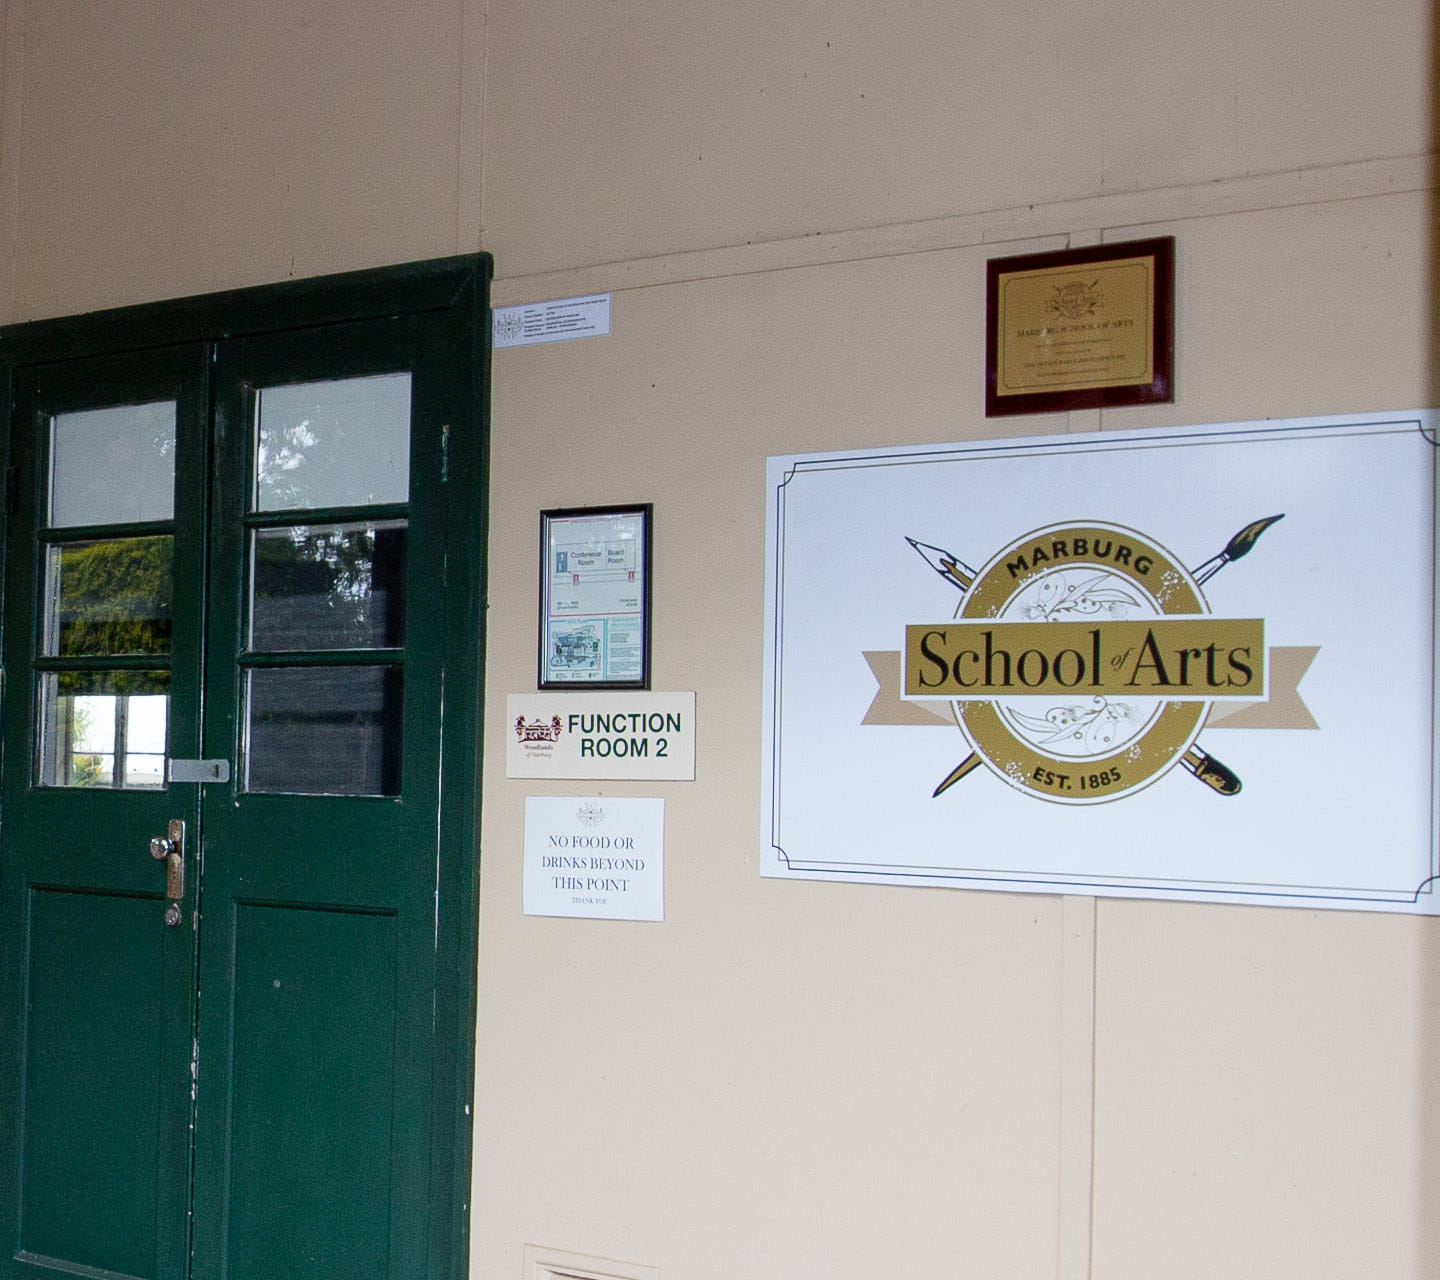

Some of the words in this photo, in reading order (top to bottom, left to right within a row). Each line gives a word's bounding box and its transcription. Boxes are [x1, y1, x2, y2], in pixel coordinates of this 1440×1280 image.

[1006, 538, 1154, 579] MARBURG
[919, 628, 1102, 688] School
[1110, 646, 1129, 672] of
[1123, 627, 1253, 688] Arts
[568, 713, 681, 734] FUNCTION
[581, 738, 648, 758] ROOM
[656, 738, 668, 757] 2
[1032, 766, 1072, 790] EST.
[1080, 766, 1121, 790] 1885
[549, 835, 569, 848] NO
[572, 835, 611, 849] FOOD
[614, 836, 634, 849] OR
[542, 856, 587, 869] DRINKS
[590, 857, 645, 871] BEYOND
[552, 876, 583, 890] THIS
[587, 878, 630, 892] POINT
